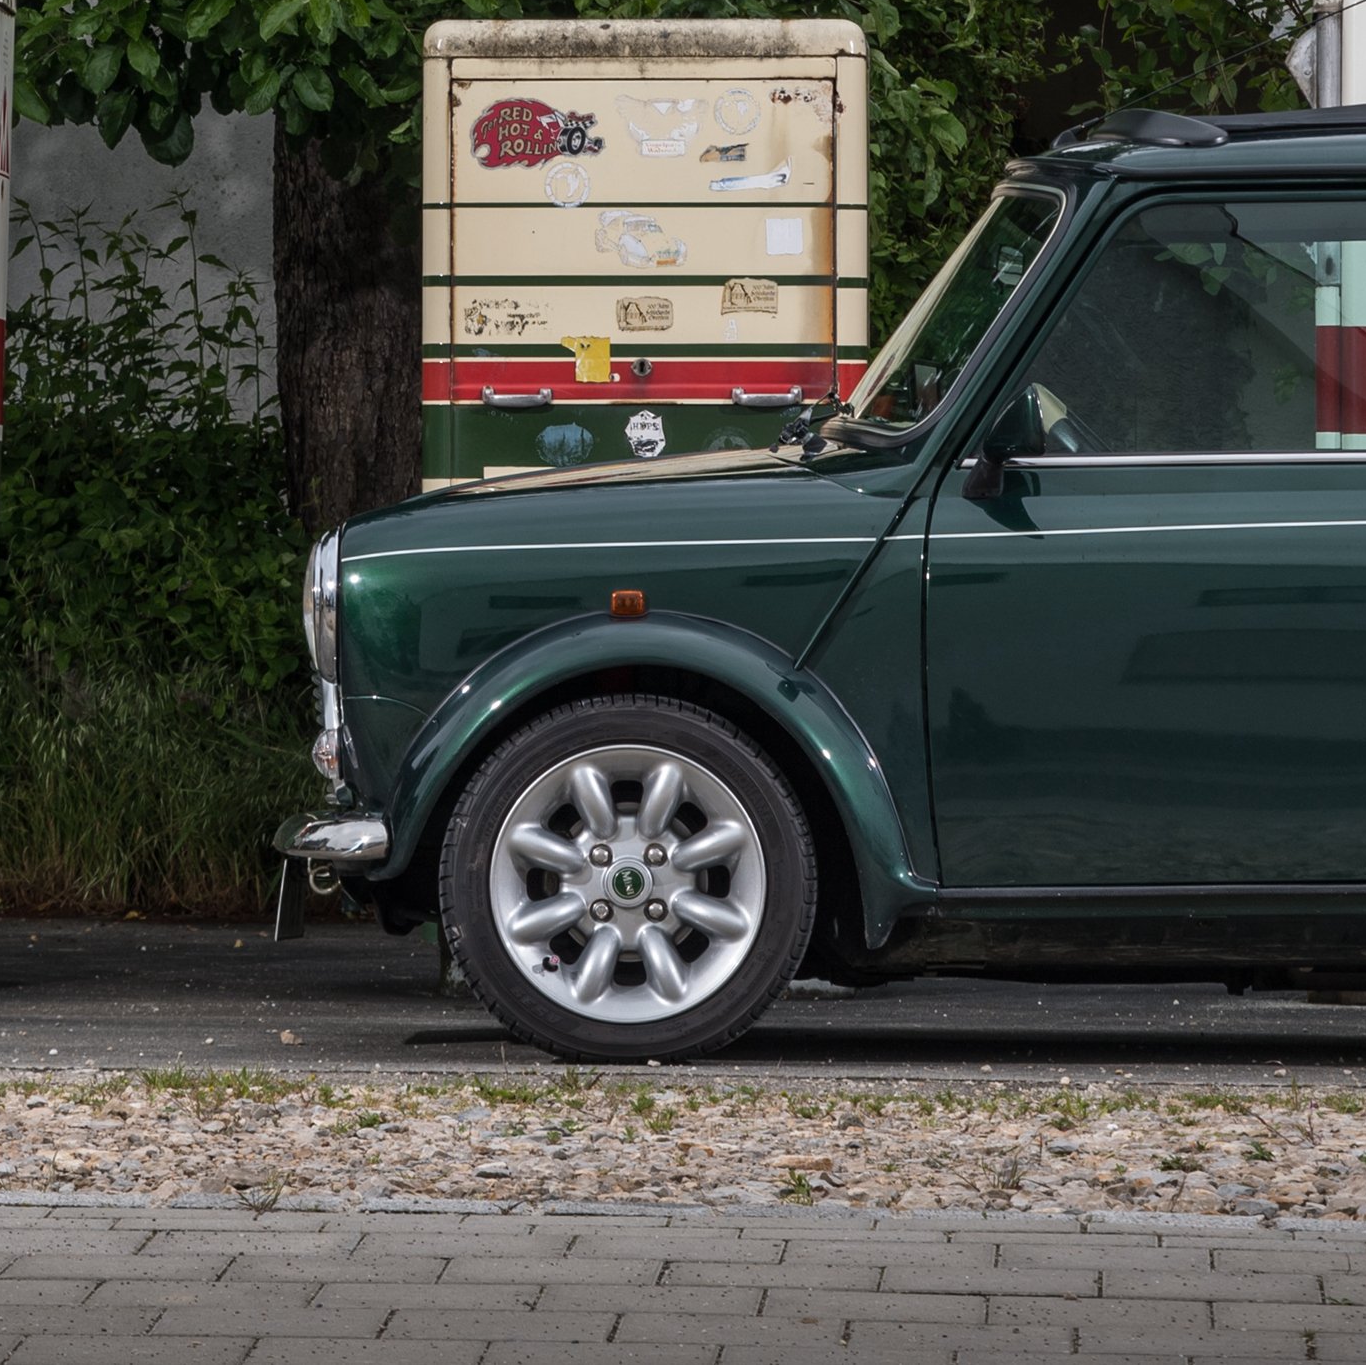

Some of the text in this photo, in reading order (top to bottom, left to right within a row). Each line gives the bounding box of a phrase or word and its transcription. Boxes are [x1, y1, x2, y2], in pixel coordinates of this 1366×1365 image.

[498, 106, 533, 124] RED
[497, 122, 531, 141] HOT
[620, 870, 635, 896] MINI
